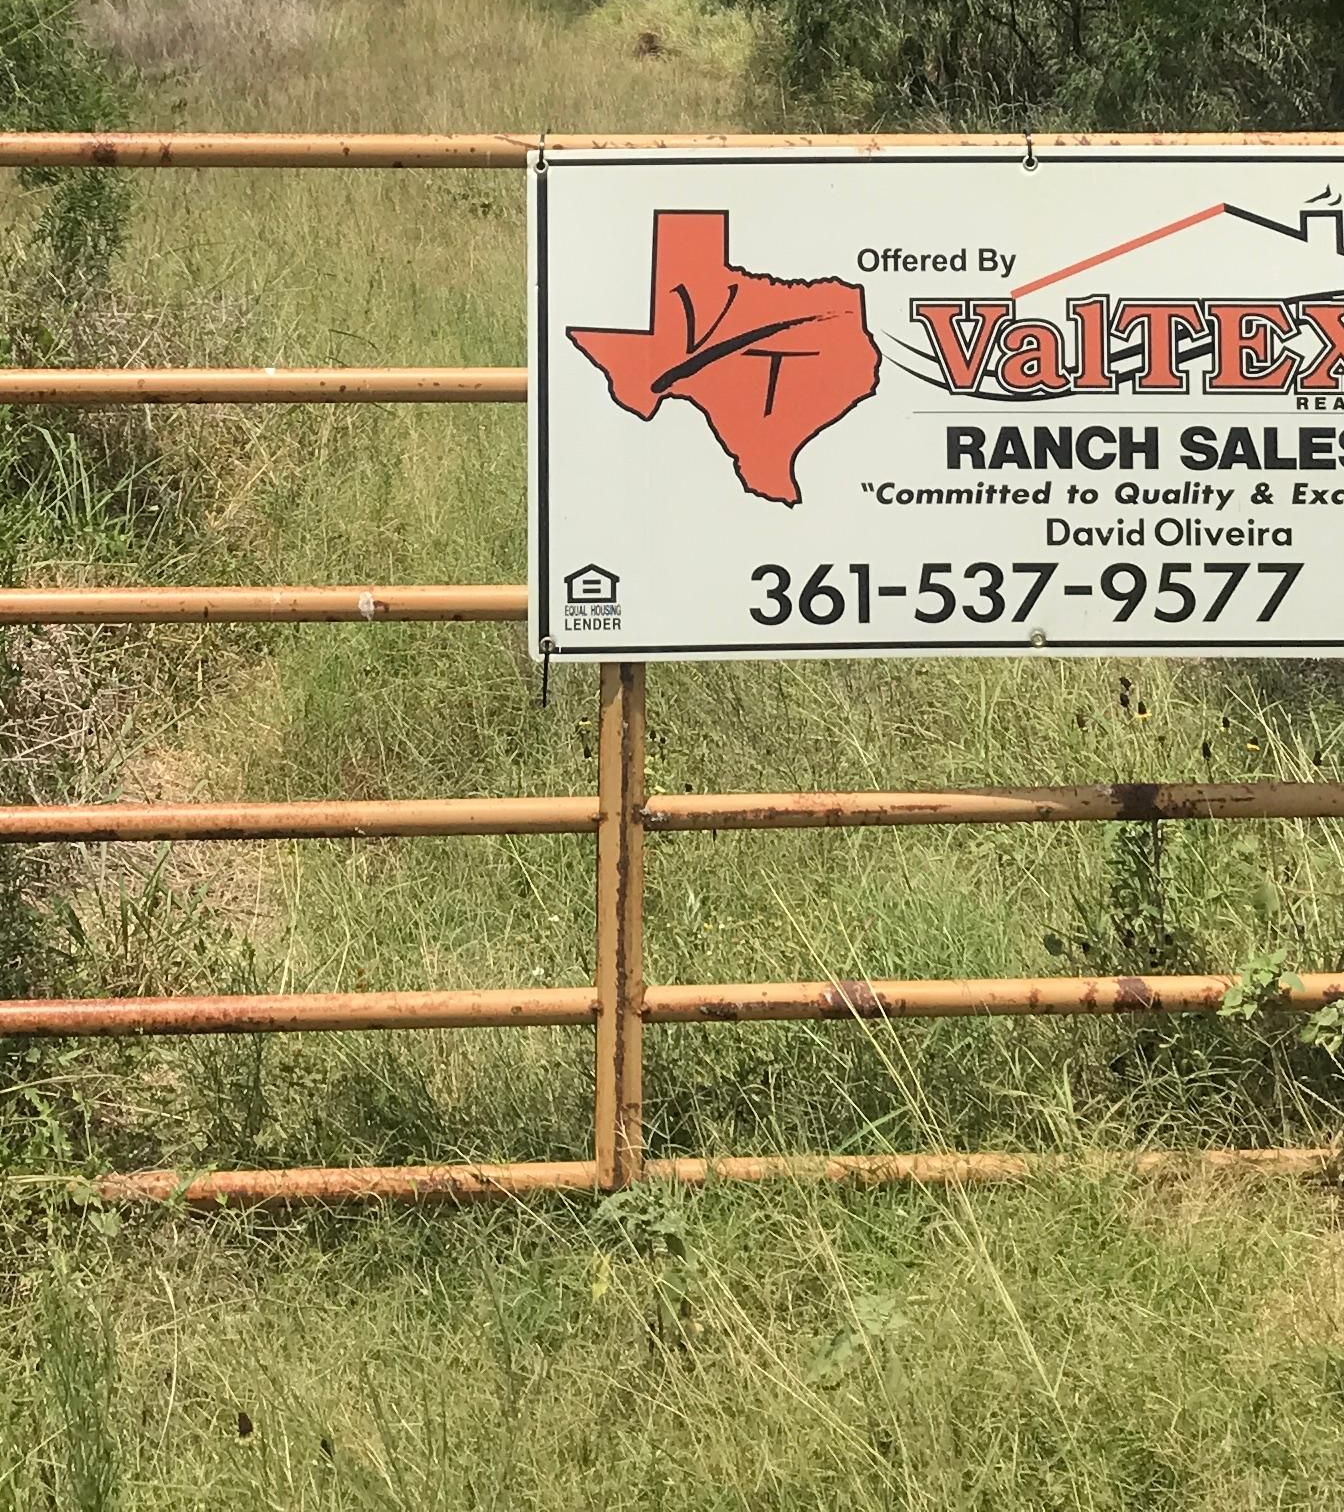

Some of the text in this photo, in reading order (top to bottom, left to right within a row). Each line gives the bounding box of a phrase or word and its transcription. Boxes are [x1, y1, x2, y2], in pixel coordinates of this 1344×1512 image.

[857, 248, 1017, 279] Offered By
[946, 425, 1160, 471] RANCH
[861, 481, 1052, 506] "Committed
[1066, 484, 1099, 505] to
[1114, 480, 1235, 511] Quality
[1250, 482, 1274, 505] &
[1046, 517, 1293, 547] David Oliveira
[749, 561, 1305, 626] 361-537-9577
[564, 605, 587, 616] EQUAL
[564, 618, 621, 631] LENDER
